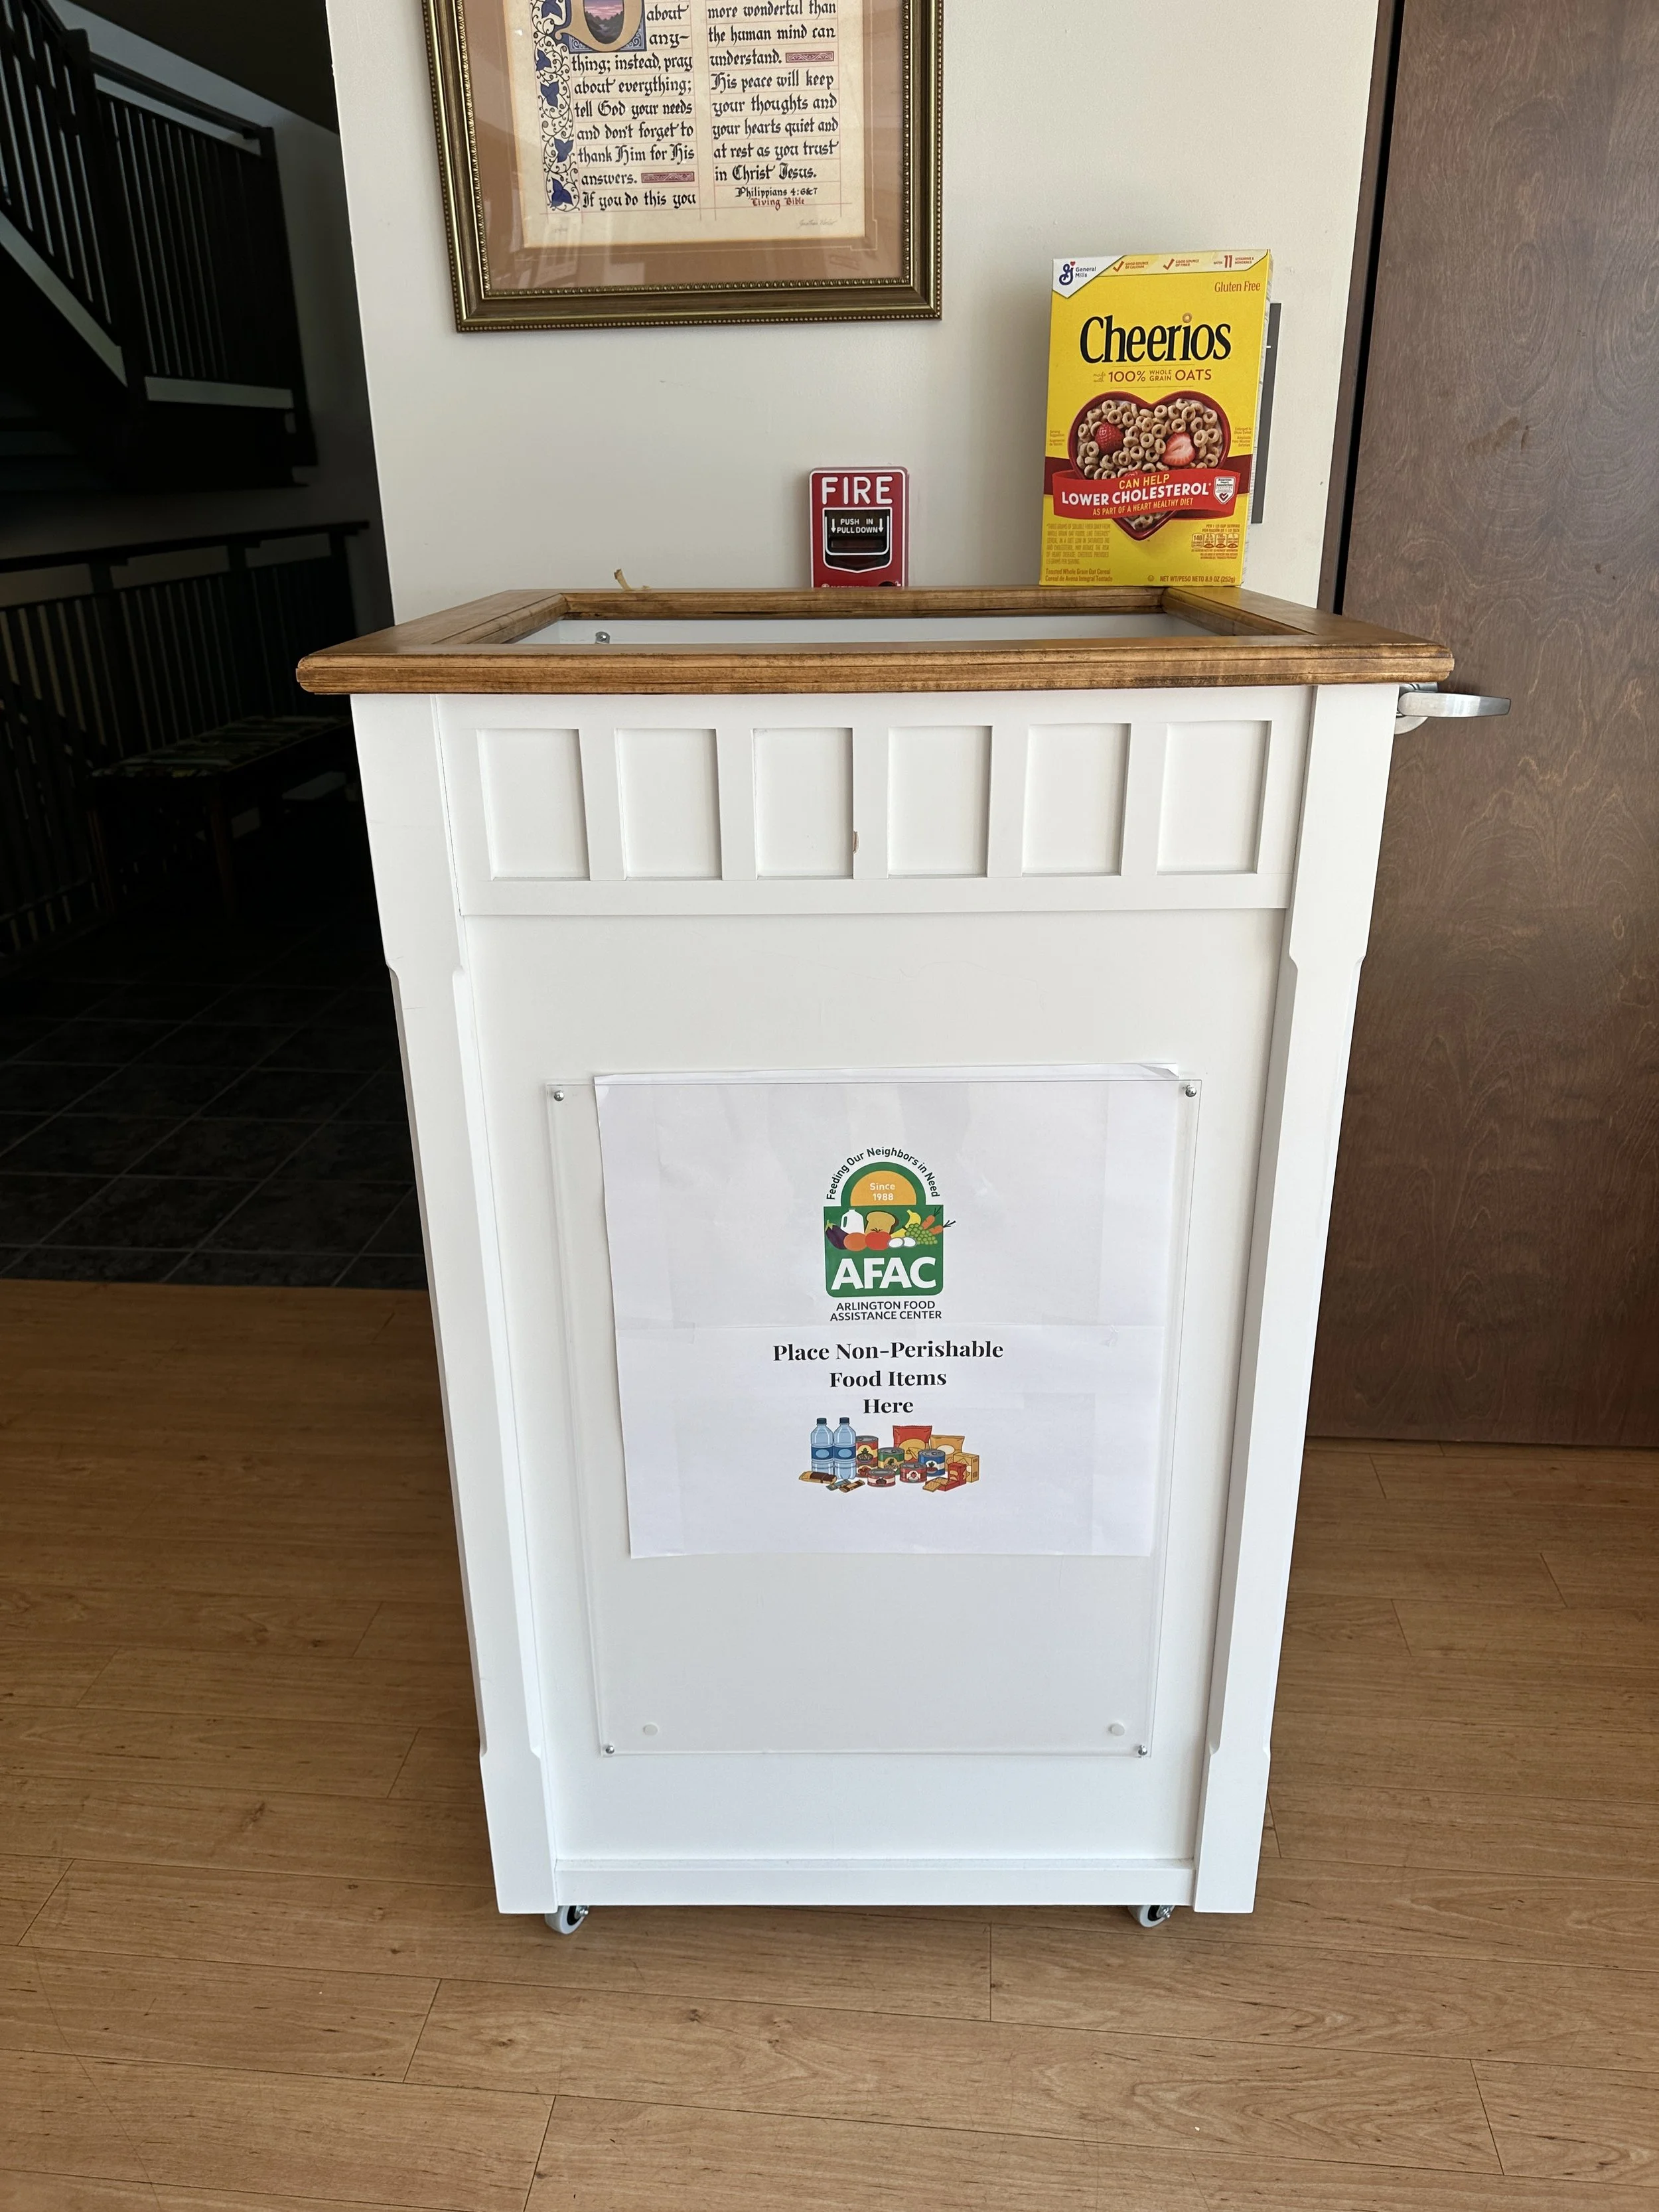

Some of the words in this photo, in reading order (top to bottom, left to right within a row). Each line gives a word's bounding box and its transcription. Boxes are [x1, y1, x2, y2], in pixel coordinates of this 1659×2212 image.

[646, 4, 689, 21] about
[707, 6, 738, 19] more
[743, 0, 802, 17] wonderful
[809, 0, 836, 19] than
[709, 25, 725, 47] the
[731, 25, 771, 45] human
[776, 24, 807, 39] mind
[812, 27, 836, 38] can
[571, 54, 611, 76] thing;
[614, 52, 661, 70] instead,
[664, 56, 693, 72] pray
[709, 48, 782, 66] understand.
[574, 77, 616, 94] about
[618, 74, 691, 96] everything;
[711, 72, 737, 94] His
[741, 76, 772, 93] peace
[776, 69, 799, 87] will
[806, 69, 833, 90] keep
[575, 100, 593, 117] tell
[598, 100, 626, 116] God
[631, 104, 658, 119] your
[663, 99, 693, 114] needs
[712, 101, 745, 117] your
[751, 94, 808, 115] thoughts
[813, 92, 837, 110] and
[577, 125, 600, 140] and
[605, 124, 634, 139] don't
[638, 121, 679, 142] forget
[680, 121, 693, 137] to
[712, 125, 741, 139] your
[745, 118, 781, 139] hearts
[784, 117, 815, 137] quiet
[818, 116, 839, 132] and
[578, 145, 612, 167] thank
[614, 145, 646, 166] Him
[650, 144, 668, 161] for
[669, 143, 695, 165] His
[713, 143, 727, 159] at
[730, 143, 754, 158] rest
[757, 147, 770, 157] as
[774, 145, 799, 160] you
[803, 139, 839, 155] trust
[581, 173, 637, 185] answers.
[715, 167, 727, 181] in
[732, 164, 776, 184] Christ
[778, 163, 817, 179] Jesus.
[582, 191, 595, 208] If
[599, 196, 622, 211] you
[624, 192, 638, 206] do
[644, 190, 666, 208] this
[673, 194, 696, 209] you
[735, 186, 787, 199] Philippians
[751, 197, 780, 211] Living
[1224, 255, 1232, 268] 11
[1214, 281, 1242, 293] Gluten
[1244, 281, 1261, 291] Free
[1080, 313, 1230, 364] Cheerios
[1108, 370, 1146, 382] 100%
[1175, 369, 1212, 381] OATS
[822, 477, 893, 504] FIRE
[1119, 479, 1139, 489] CAN
[1143, 474, 1170, 486] HELP
[1062, 492, 1109, 506] LOWER
[1112, 482, 1210, 504] CHOLESTEROL
[1133, 502, 1151, 512] HEART
[1153, 499, 1179, 510] HEALTHY
[826, 1165, 850, 1200] Feeding
[846, 1152, 864, 1166] Our
[866, 1146, 919, 1166] Neighbors
[917, 1162, 927, 1173] in
[924, 1172, 940, 1197] Need
[831, 1256, 936, 1290] AFAC
[830, 1311, 896, 1321] ASSISTANCE
[900, 1311, 942, 1319] CENTER
[836, 1301, 901, 1311] ARLINGTON
[904, 1301, 935, 1309] FOOD
[773, 1344, 830, 1361] Place
[835, 1341, 1004, 1360] Non-Perishable
[830, 1370, 882, 1388] Food
[888, 1371, 946, 1387] Items
[863, 1398, 914, 1414] Here
